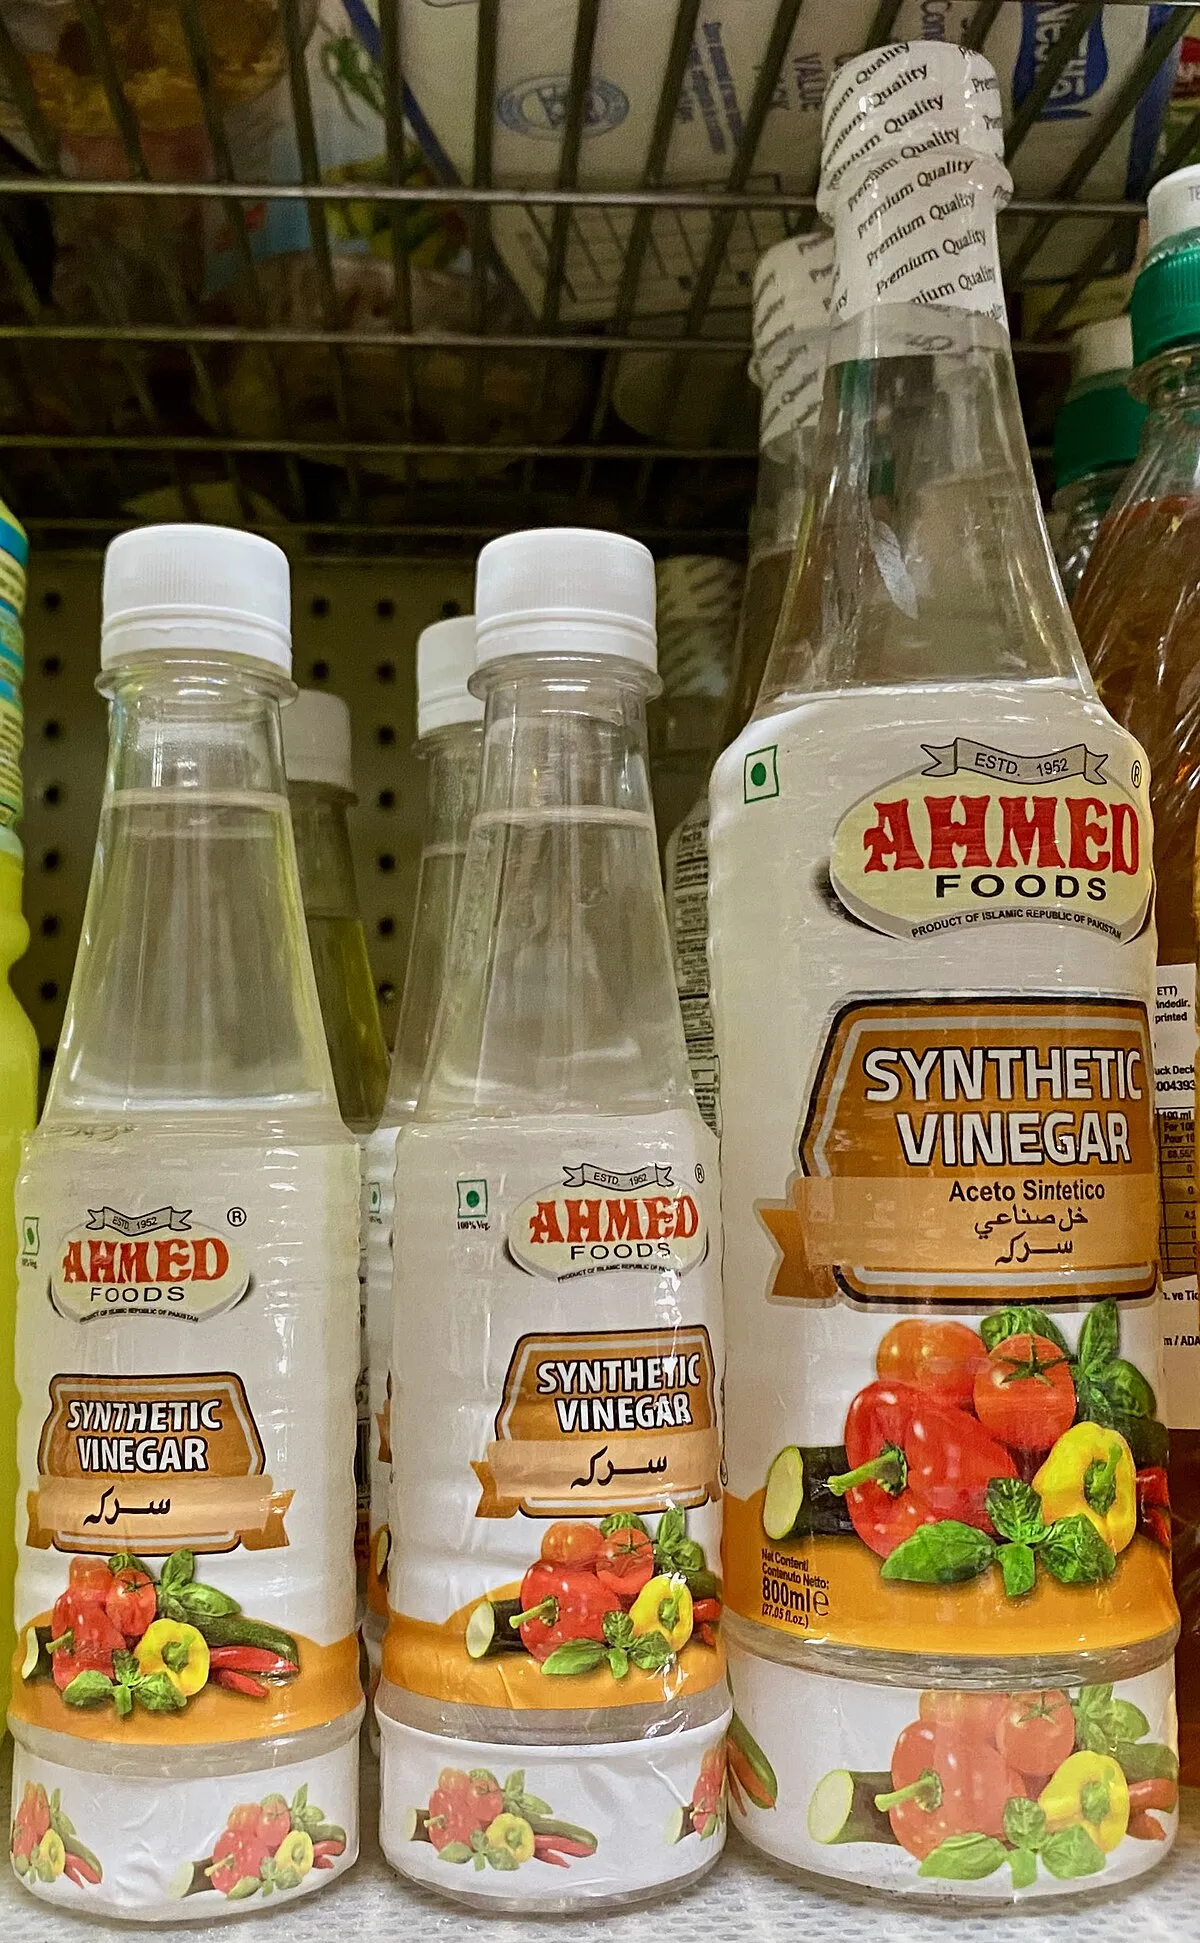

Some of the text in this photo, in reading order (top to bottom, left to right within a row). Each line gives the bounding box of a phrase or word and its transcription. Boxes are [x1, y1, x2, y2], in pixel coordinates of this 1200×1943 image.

[855, 43, 910, 84] Quality
[867, 63, 928, 108] Quality
[884, 95, 943, 134] Quality
[901, 127, 960, 158] Quality
[857, 159, 974, 239] Premium Quality
[867, 215, 925, 266] Premium
[929, 191, 975, 221] Quality
[876, 247, 939, 295] Premium
[942, 229, 986, 256] Quality
[958, 264, 996, 291] Quality
[974, 752, 1069, 777] ESTD. 1952
[863, 795, 1139, 875] AHMED
[936, 874, 1107, 901] FOODS
[911, 908, 1122, 939] PRODUCT OF ISLAMIC REPUBLIC OF PAKISTAN
[1155, 1011, 1188, 1024] printed
[863, 1047, 1144, 1102] SYNTHETIC
[896, 1111, 1132, 1166] VINEGAR
[593, 1172, 620, 1186] ESTD.
[949, 1178, 1105, 1202] Aceto Sintetico
[136, 1216, 158, 1230] 1952
[529, 1195, 698, 1244] AHMED
[1058, 1206, 1089, 1232] خل
[63, 1237, 229, 1283] AHMED
[571, 1243, 671, 1261] FOODS
[90, 1286, 185, 1303] FOODS
[537, 1353, 701, 1395] SYNTHETIC
[66, 1398, 222, 1433] SYNTHETIC
[555, 1391, 693, 1433] VINEGAR
[77, 1435, 209, 1474] VINEGAR
[762, 1562, 829, 1590] Contenuto Netto:
[762, 1603, 784, 1621] (27.05
